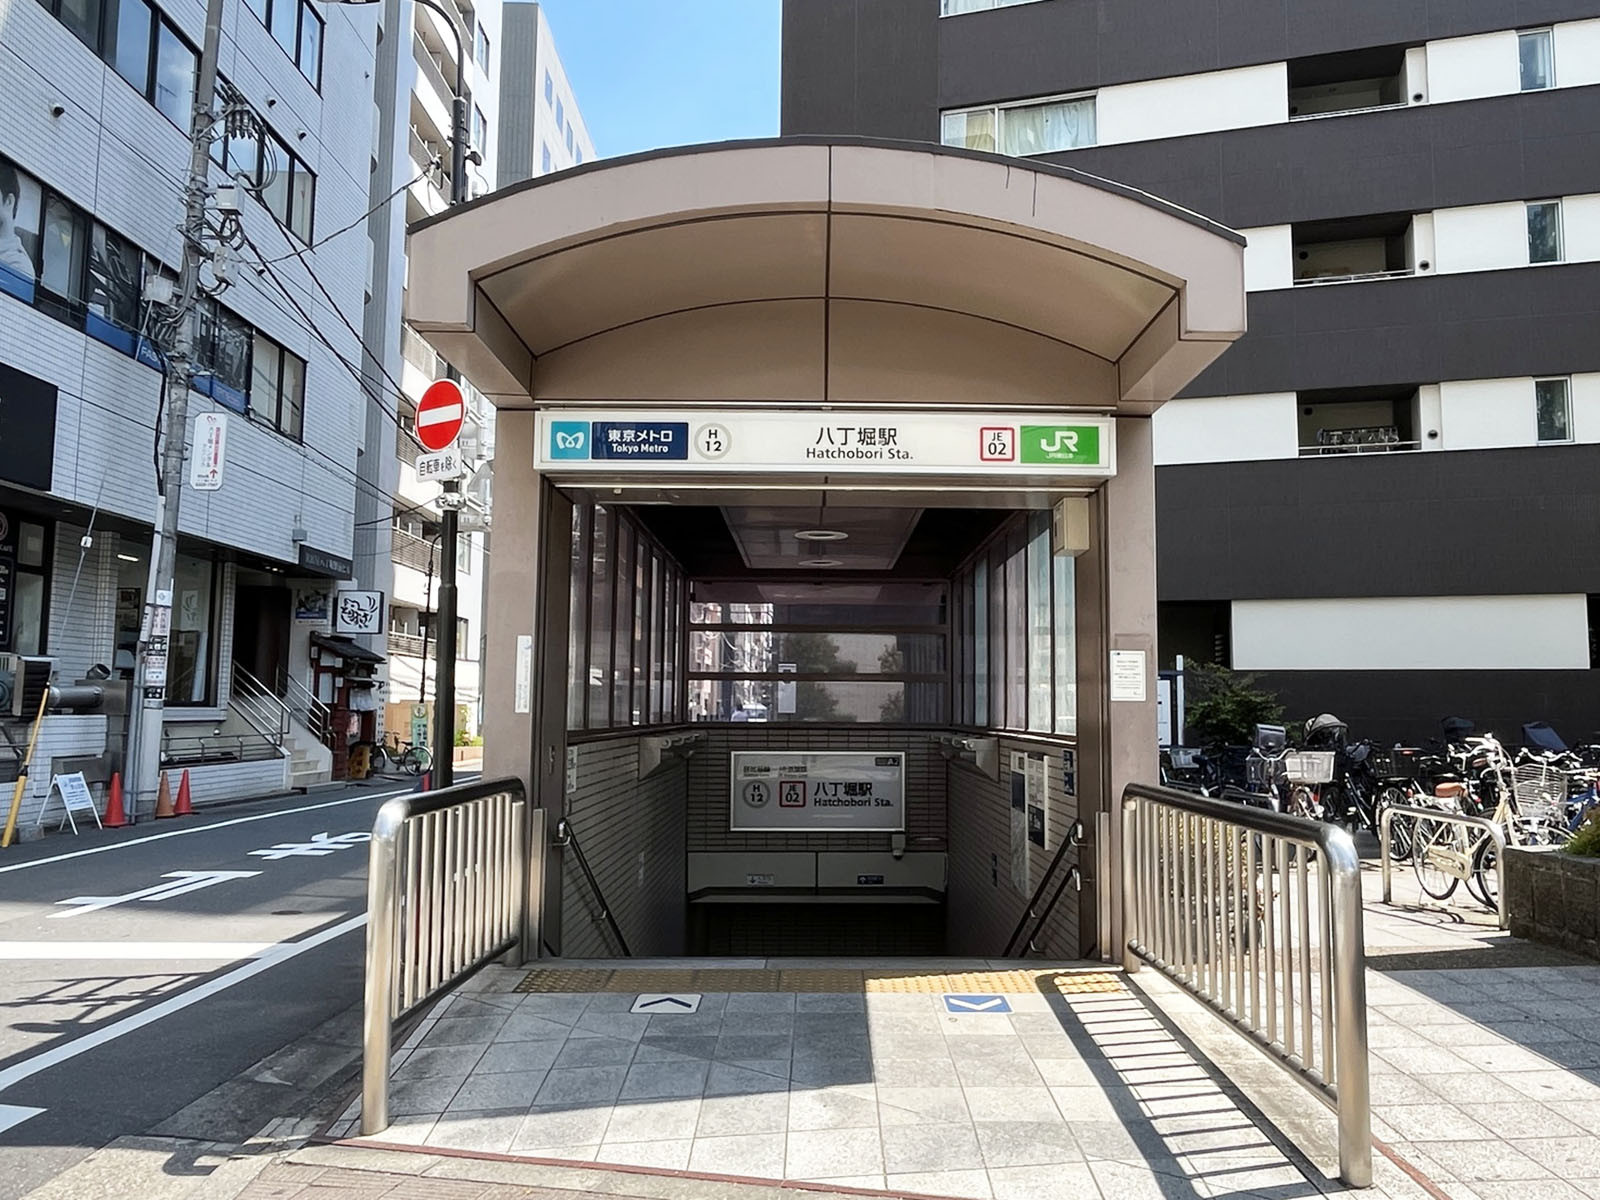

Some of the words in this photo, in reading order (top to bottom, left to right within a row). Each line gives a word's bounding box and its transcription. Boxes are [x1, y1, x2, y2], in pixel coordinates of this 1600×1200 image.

[608, 429, 673, 442] 東京メトロ
[708, 429, 718, 439] H
[816, 427, 897, 446] 八丁堀駅
[991, 432, 1003, 441] JE
[705, 440, 722, 452] 12
[1040, 431, 1078, 452] JR
[612, 443, 639, 454] Tokyo
[640, 443, 669, 453] Metro
[806, 447, 883, 459] Hatchobori
[888, 448, 914, 460] Sta.
[988, 442, 1007, 455] 02
[814, 783, 873, 796] 八丁堀駅
[750, 793, 763, 802] 12
[785, 793, 800, 802] 02
[814, 797, 871, 807] Hatchobori
[874, 798, 894, 807] Sta.
